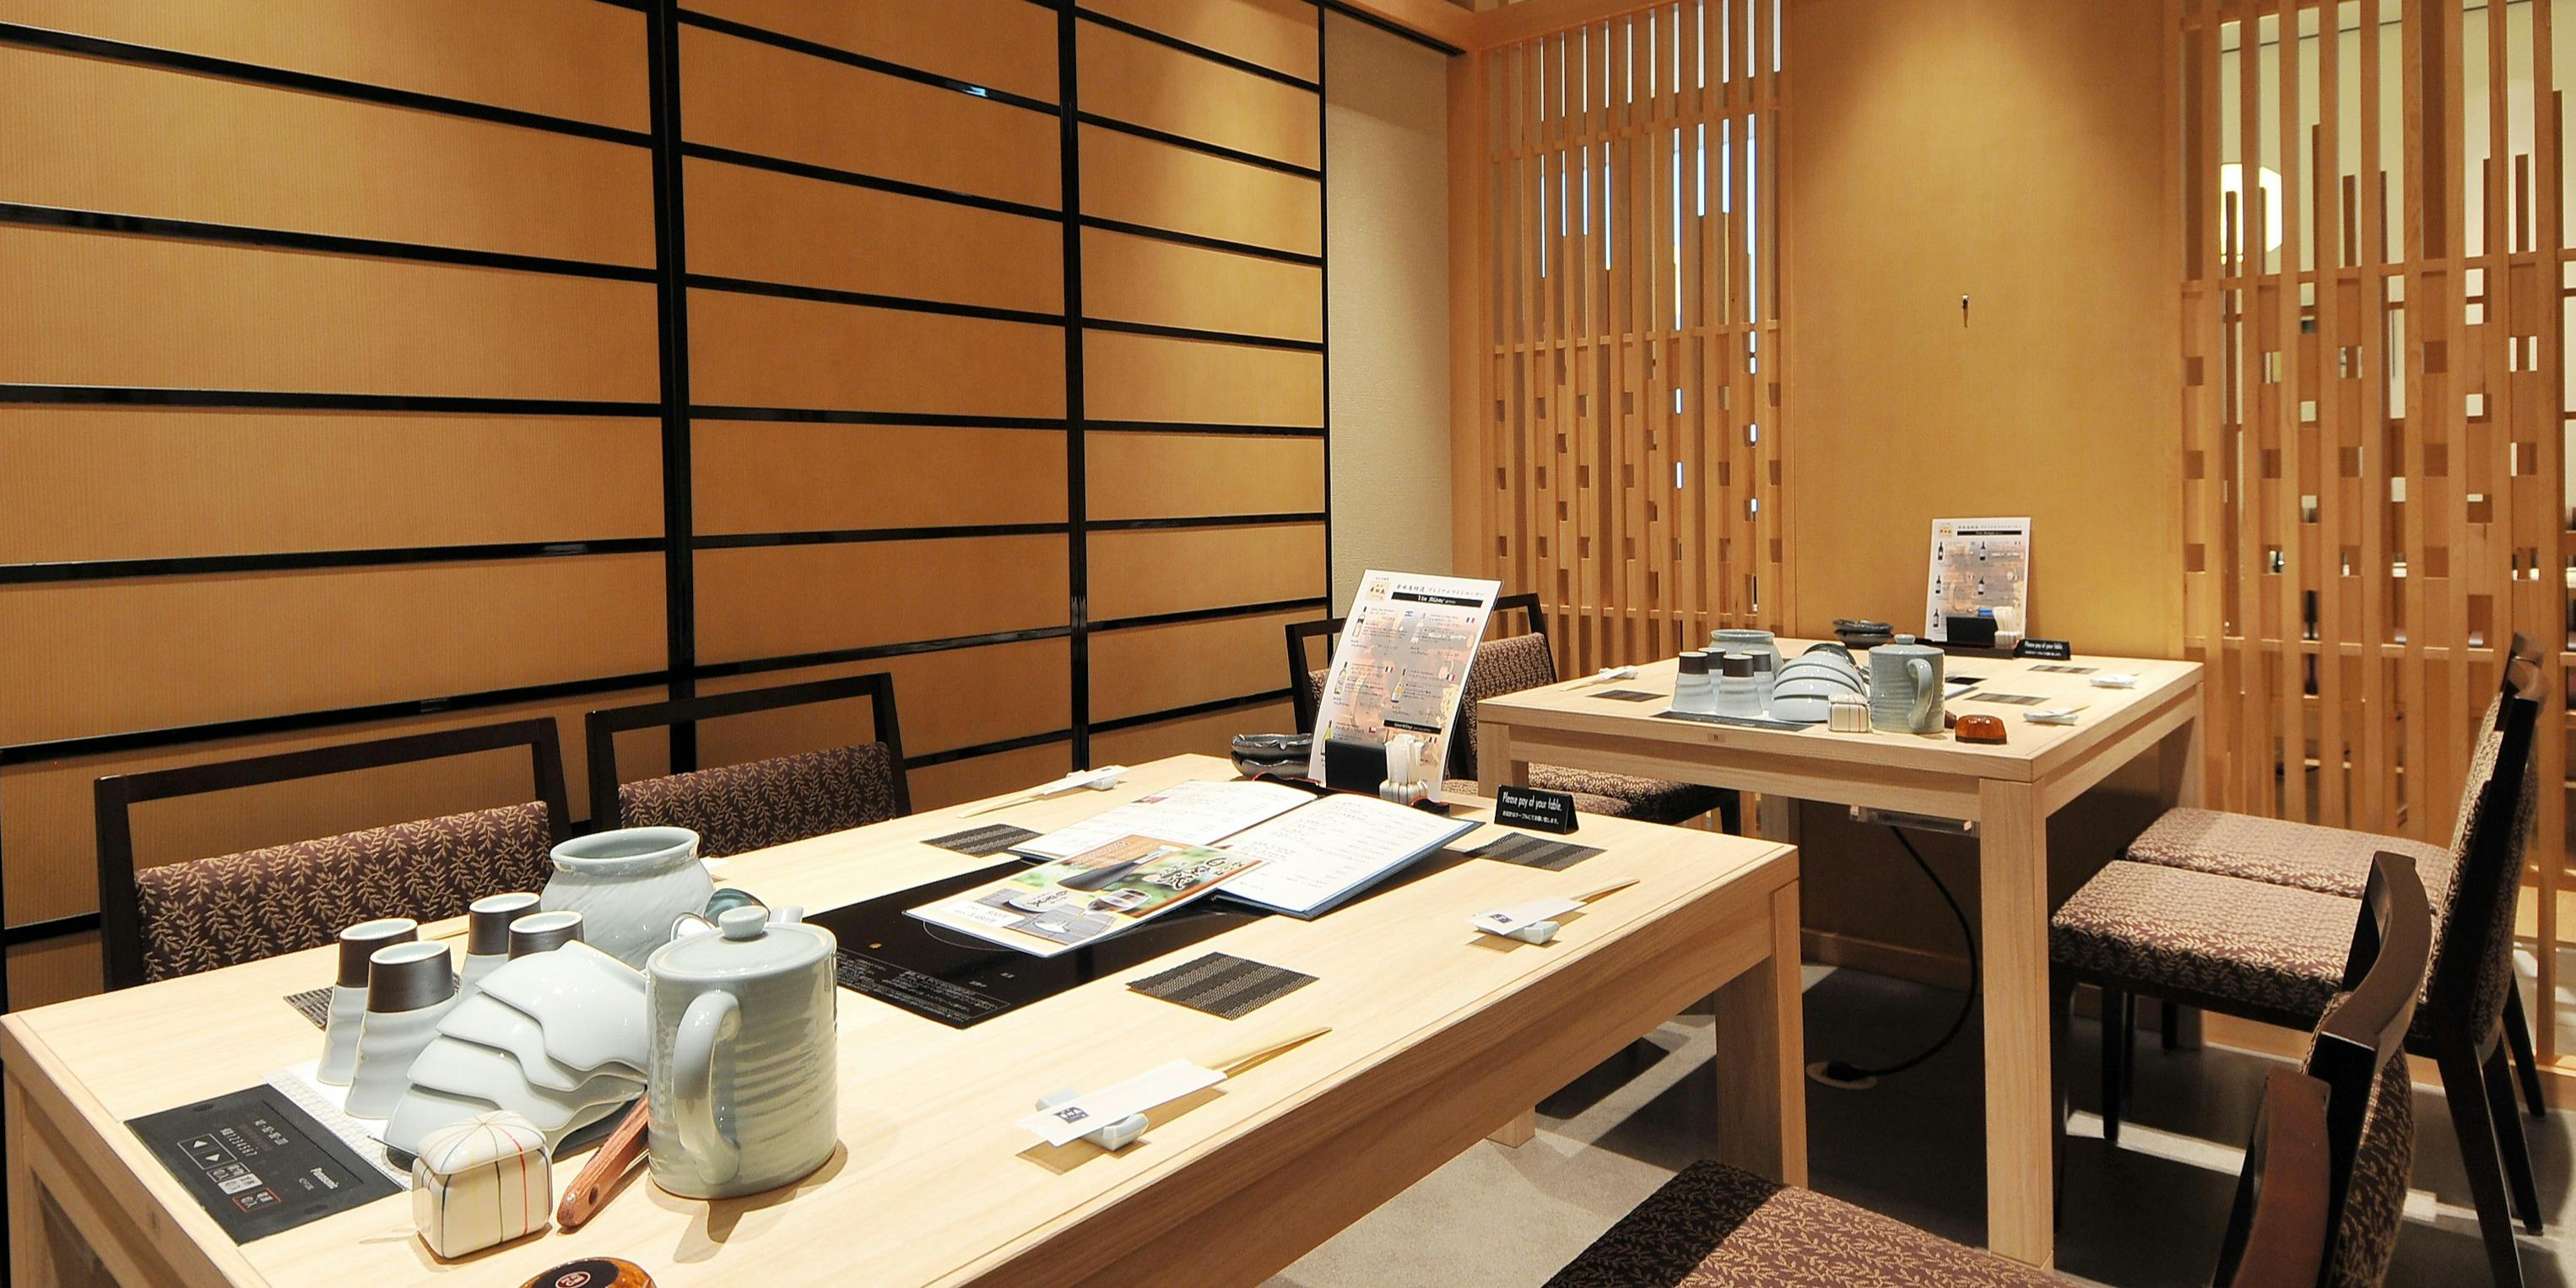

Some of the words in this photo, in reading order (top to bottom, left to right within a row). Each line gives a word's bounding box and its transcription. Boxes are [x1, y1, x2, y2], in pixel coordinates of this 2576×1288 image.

[1502, 791, 1518, 805] Please
[1518, 798, 1528, 809] pay
[1535, 800, 1547, 810] your
[310, 1167, 339, 1189] Panasonic
